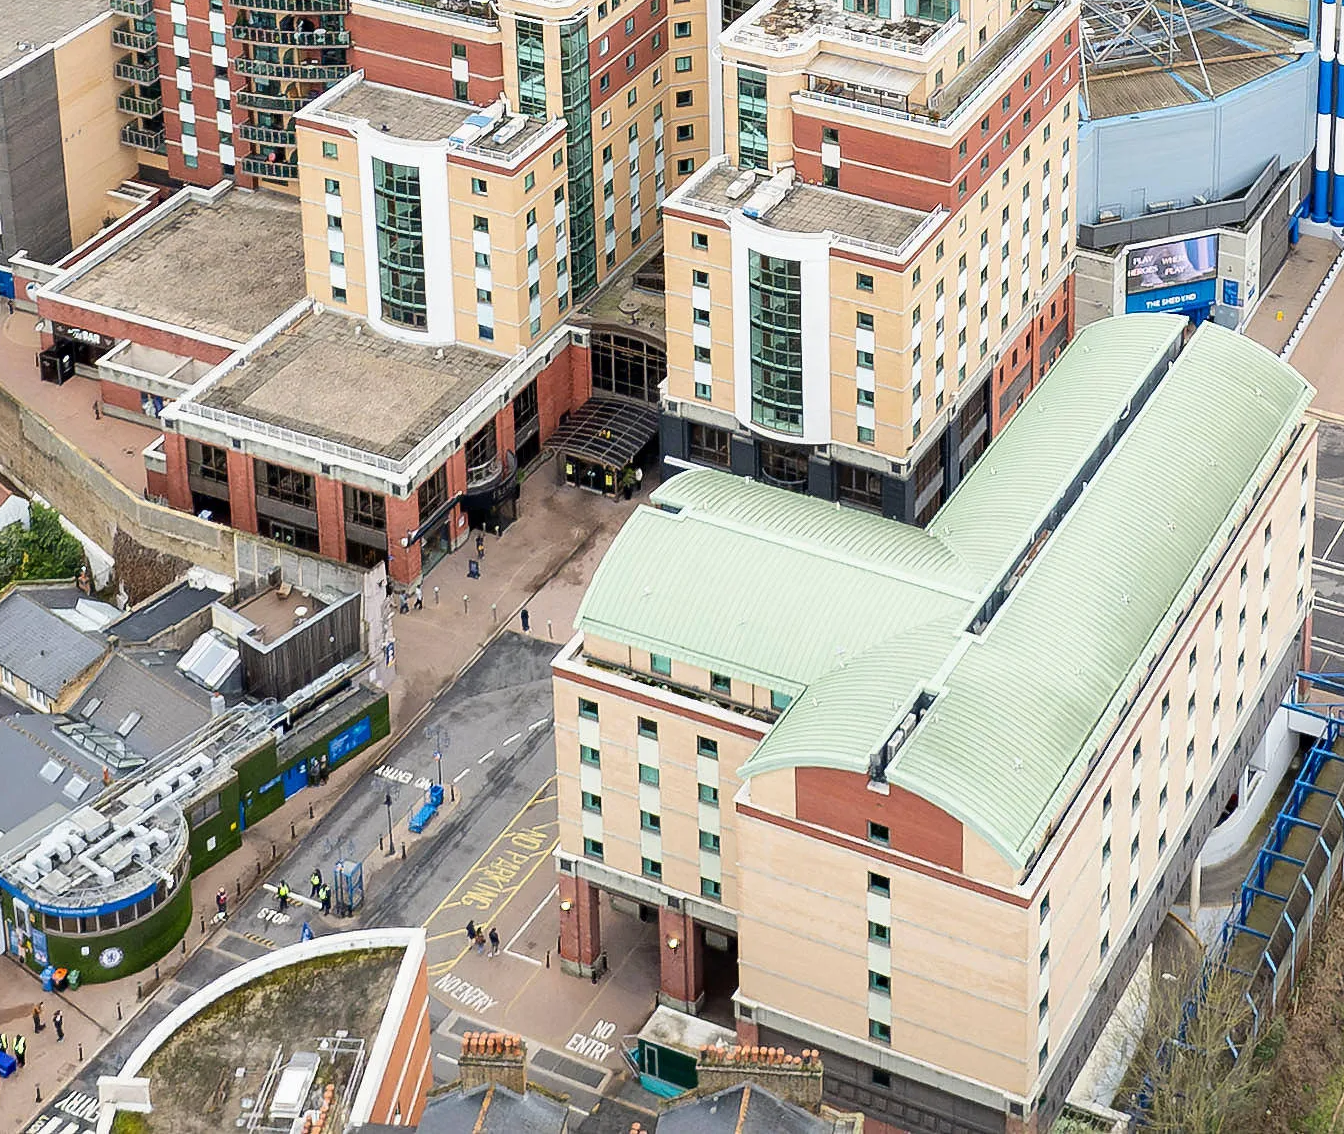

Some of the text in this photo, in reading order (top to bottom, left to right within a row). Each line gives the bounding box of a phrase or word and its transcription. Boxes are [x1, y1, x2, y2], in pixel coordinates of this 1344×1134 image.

[1133, 255, 1153, 265] PLAY
[1164, 266, 1185, 276] PLAY
[1146, 293, 1196, 309] THE SHED END
[374, 764, 431, 791] NO ENTRY
[461, 827, 548, 910] NO PARKING
[257, 907, 291, 925] STOP
[434, 973, 499, 1014] NO ENTRY
[591, 1019, 617, 1040] NO
[565, 1033, 615, 1062] ENTRY
